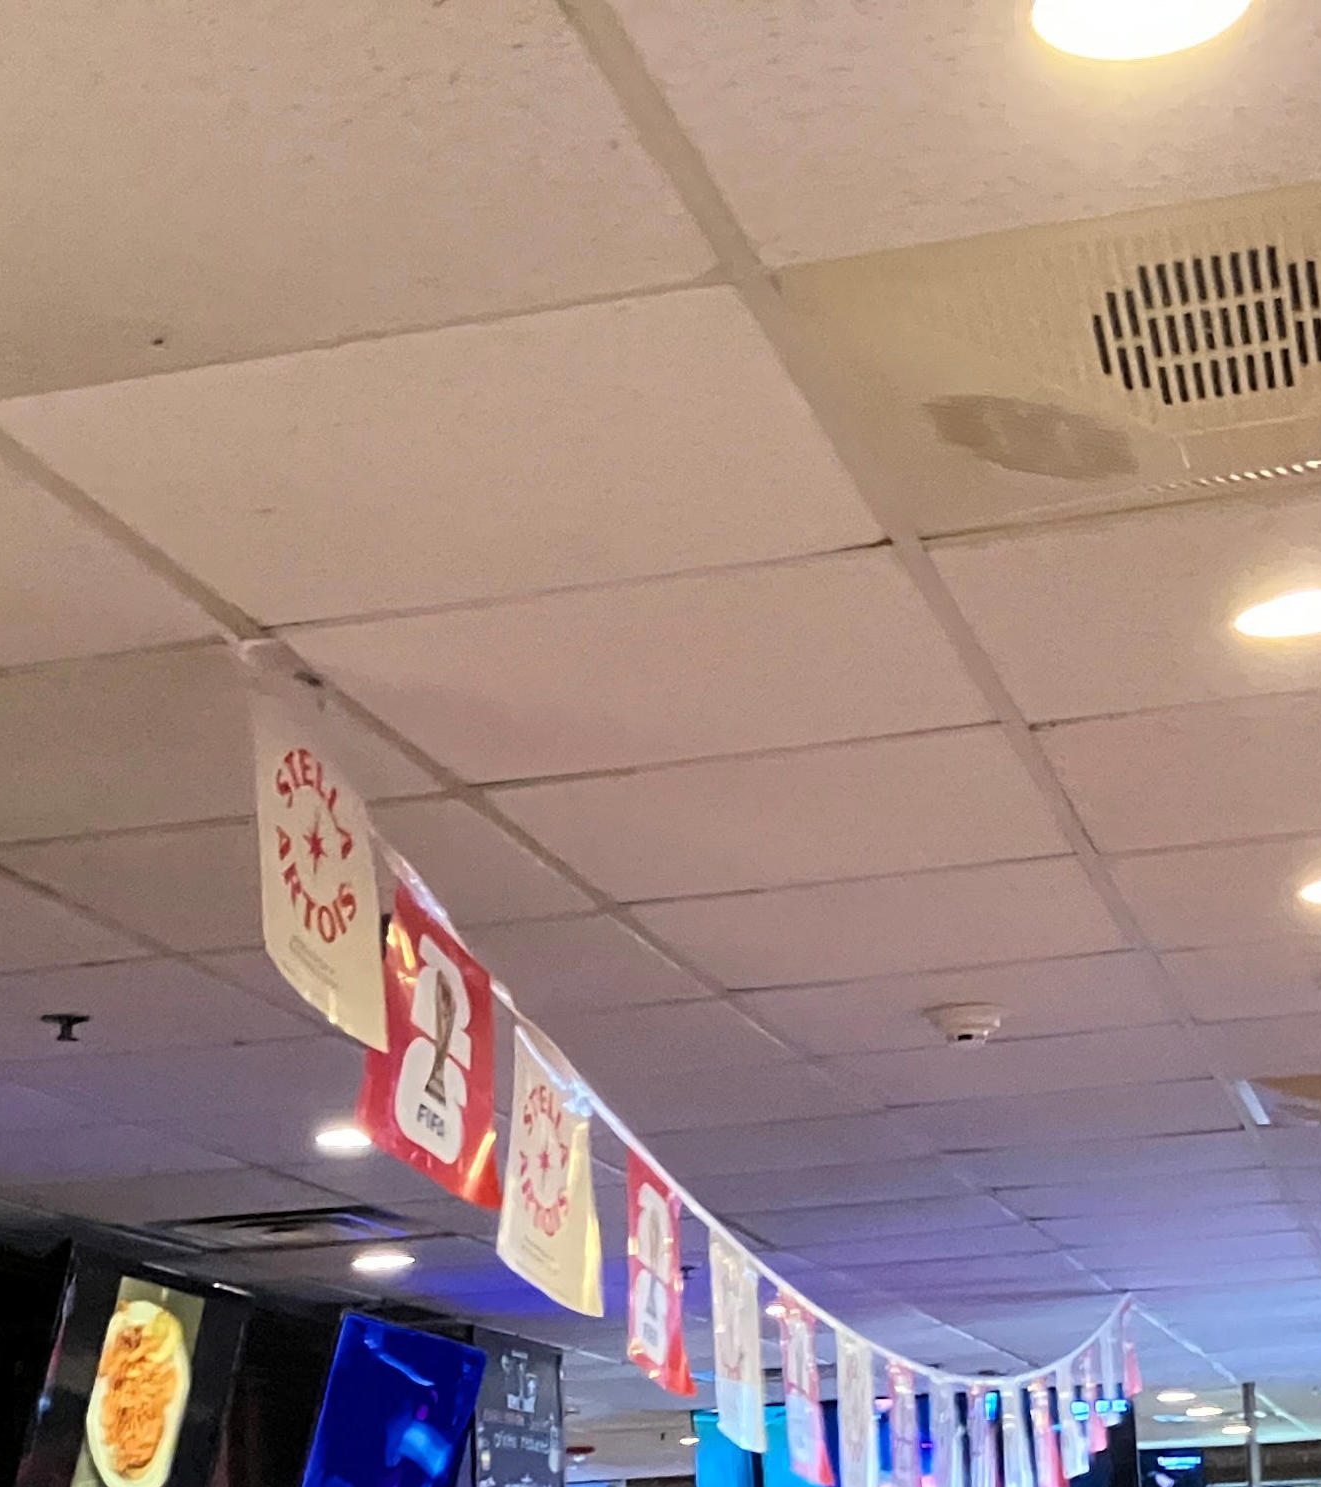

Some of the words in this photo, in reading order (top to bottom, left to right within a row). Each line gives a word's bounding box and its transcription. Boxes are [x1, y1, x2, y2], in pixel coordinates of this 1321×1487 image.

[276, 748, 353, 860] STELLA
[276, 825, 357, 944] ARTOIS
[417, 1103, 445, 1140] FIFA
